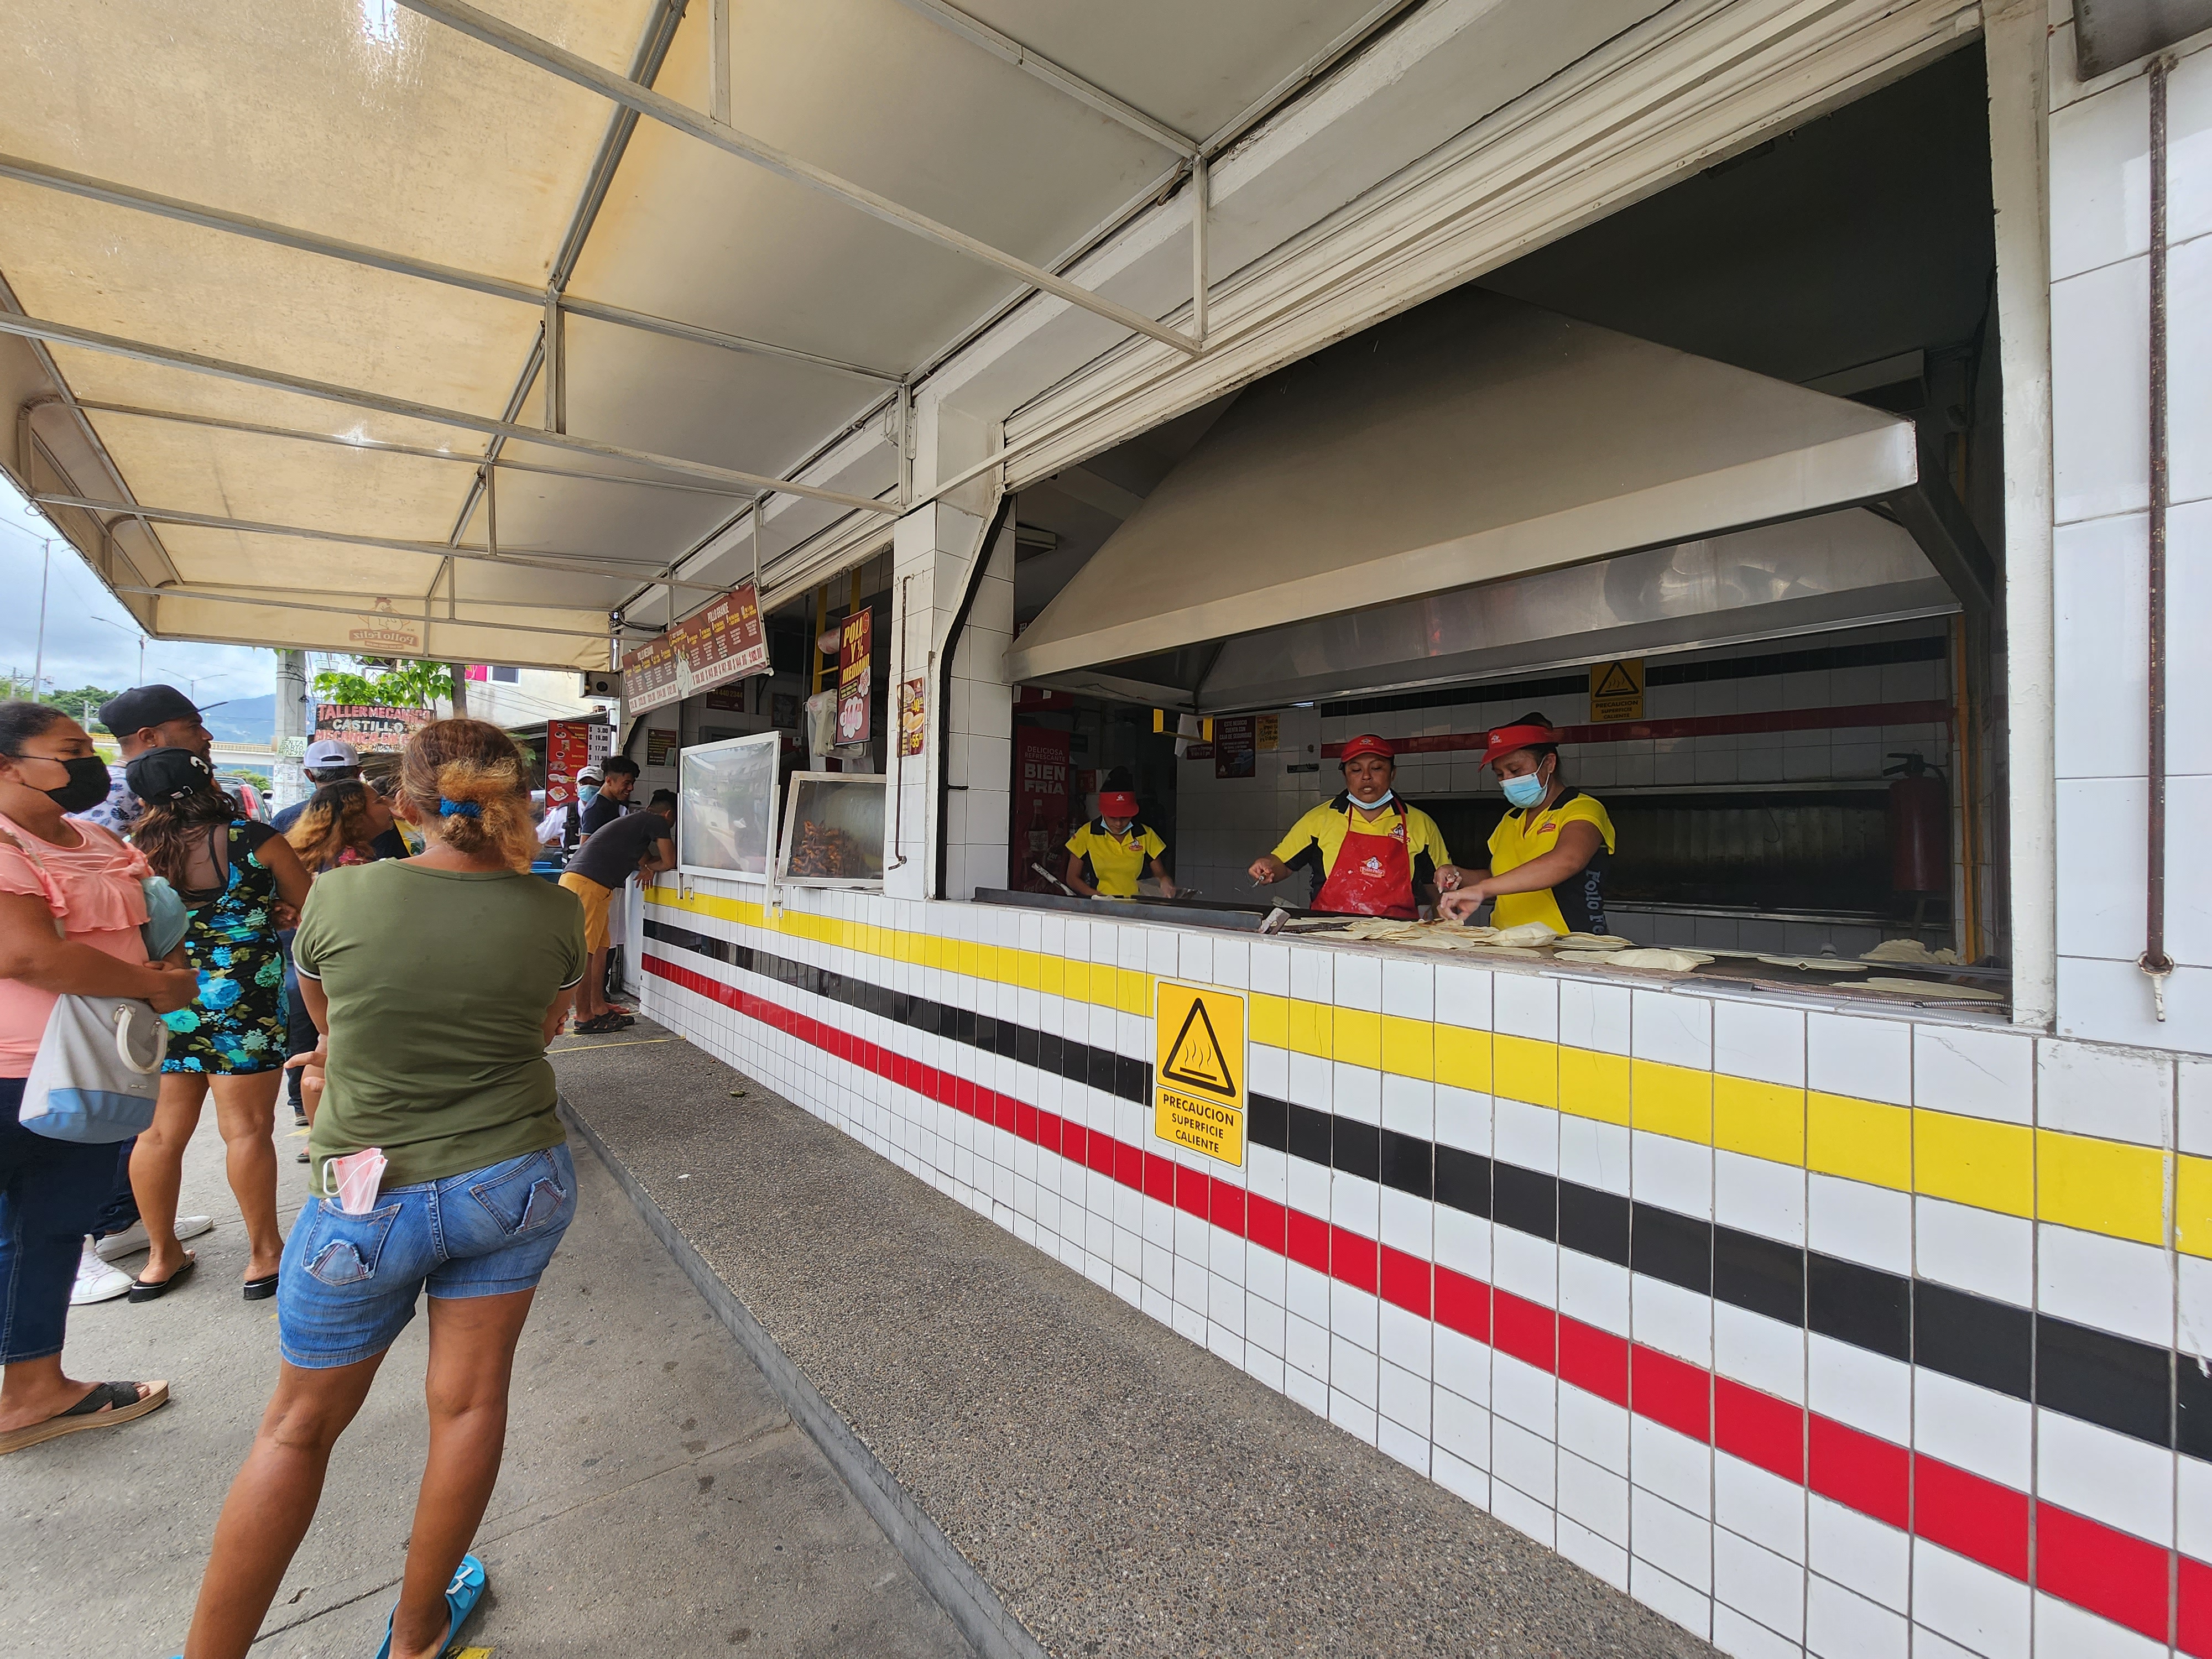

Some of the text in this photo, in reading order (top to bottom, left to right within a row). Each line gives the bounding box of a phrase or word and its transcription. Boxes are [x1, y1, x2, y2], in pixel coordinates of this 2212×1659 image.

[851, 641, 857, 664] Y
[842, 653, 870, 685] MEDIANO
[317, 705, 368, 721] TALLER
[332, 719, 404, 733] CASTILLO
[1025, 752, 1066, 762] REFRESCANTE
[1027, 745, 1063, 755] DELICIOSA
[1025, 763, 1066, 781] BIEN
[1164, 1093, 1234, 1126] PRECAUCION
[1172, 1113, 1223, 1139] SUPERFICIE
[1176, 1129, 1219, 1153] CALIENTE
